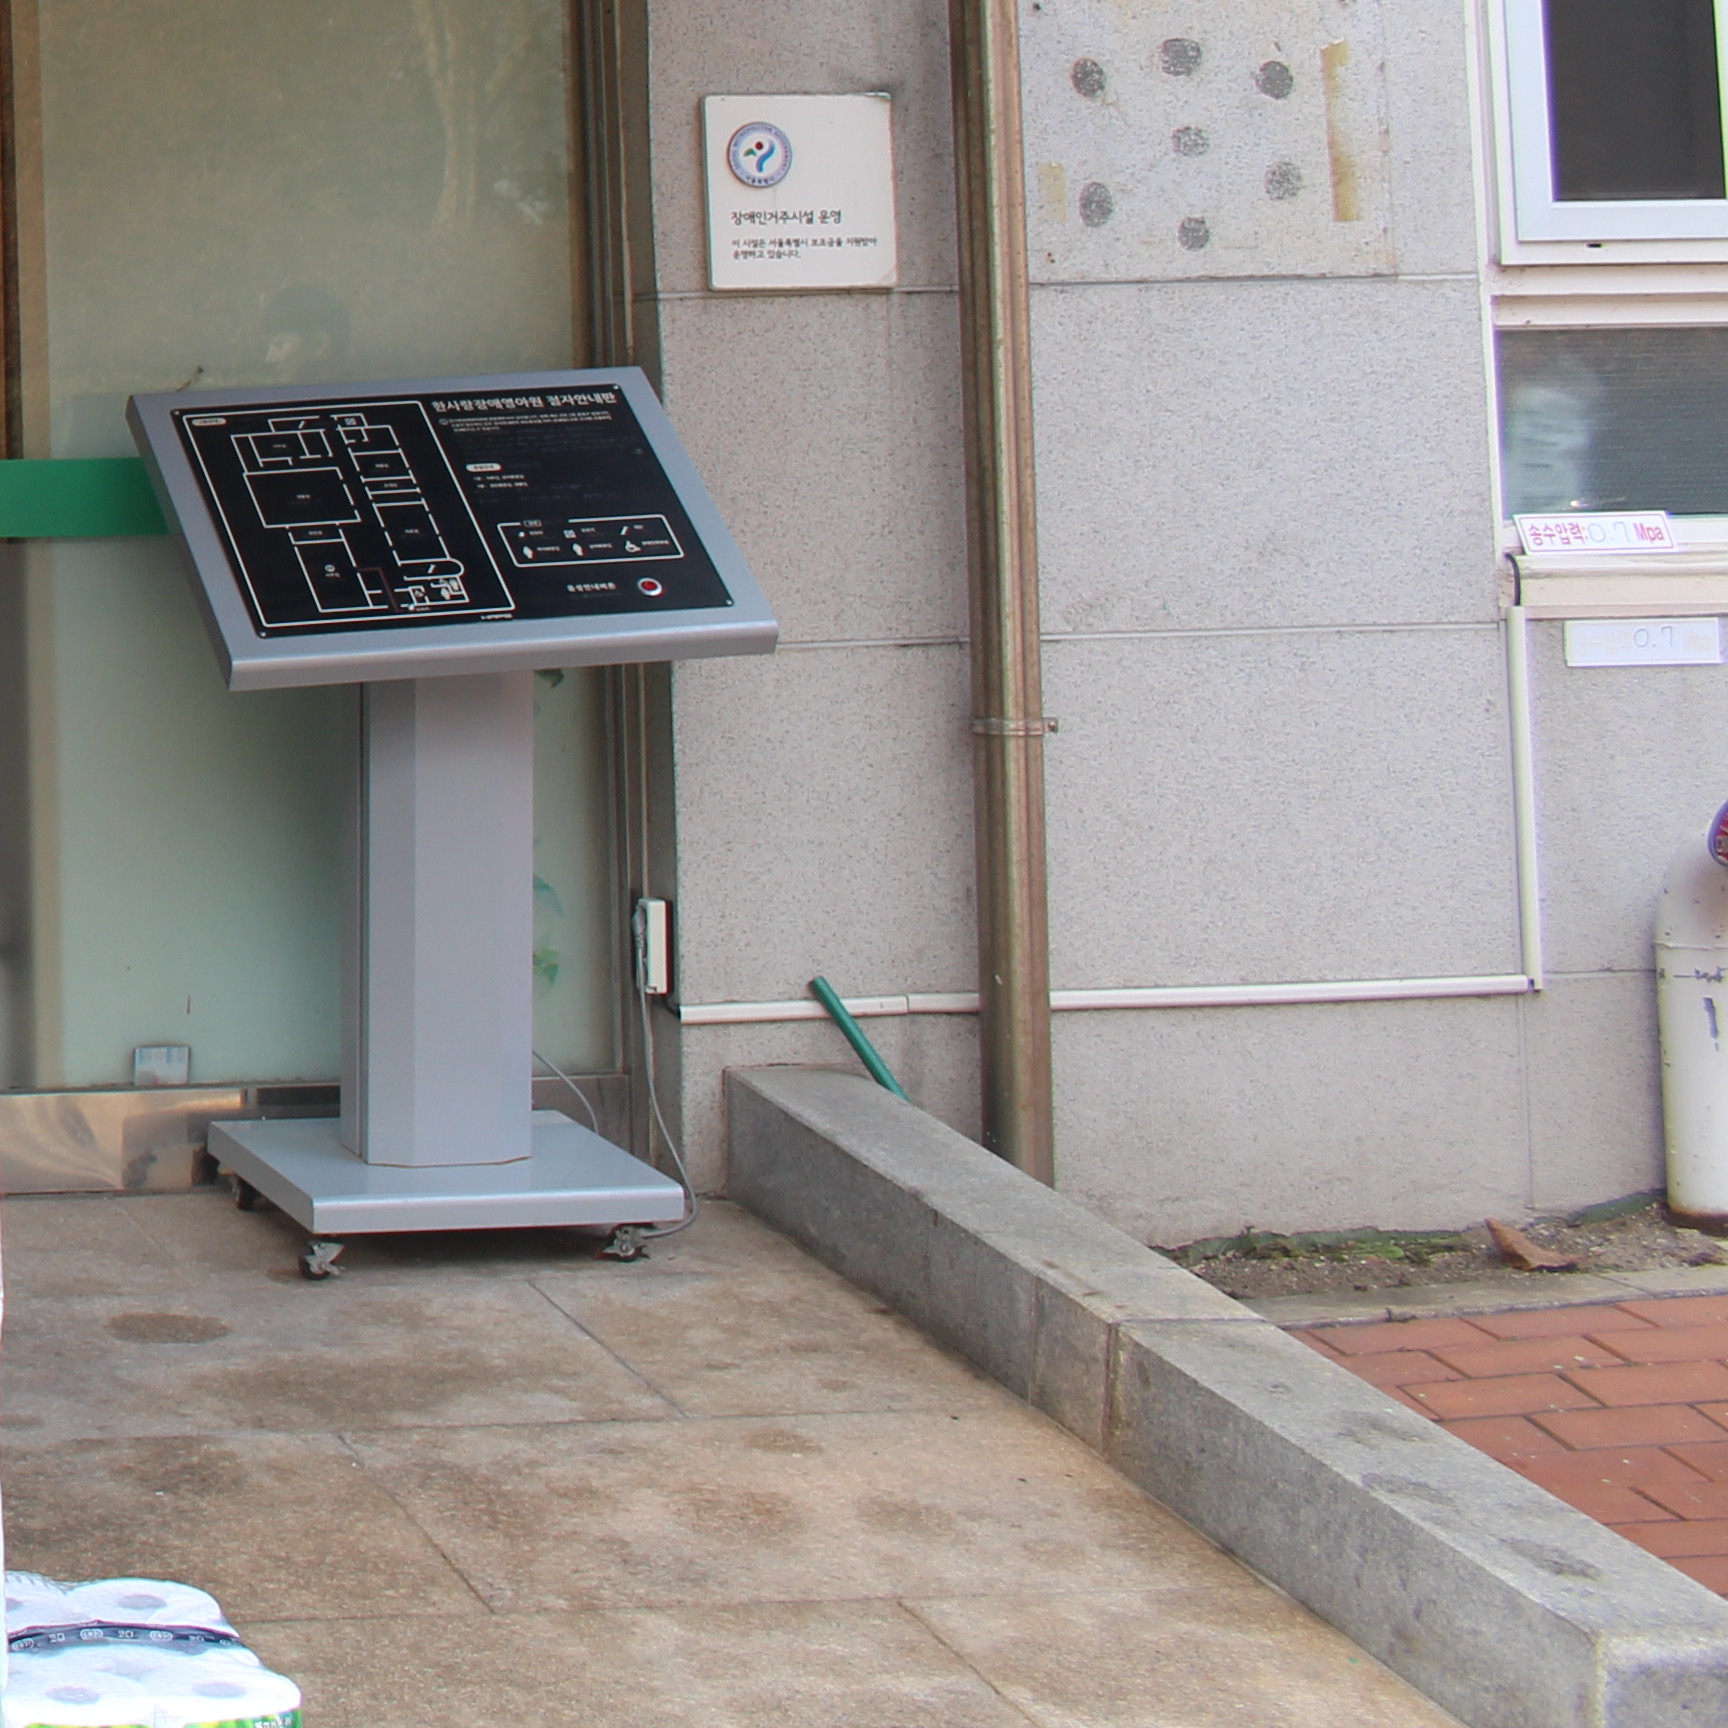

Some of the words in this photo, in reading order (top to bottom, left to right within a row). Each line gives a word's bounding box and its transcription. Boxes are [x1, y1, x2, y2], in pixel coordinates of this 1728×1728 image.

[730, 210, 814, 226] 장애인거주시설
[818, 209, 842, 224] 운영
[430, 395, 543, 413] 한사랑장애영아원
[1633, 625, 1673, 648] 0.7
